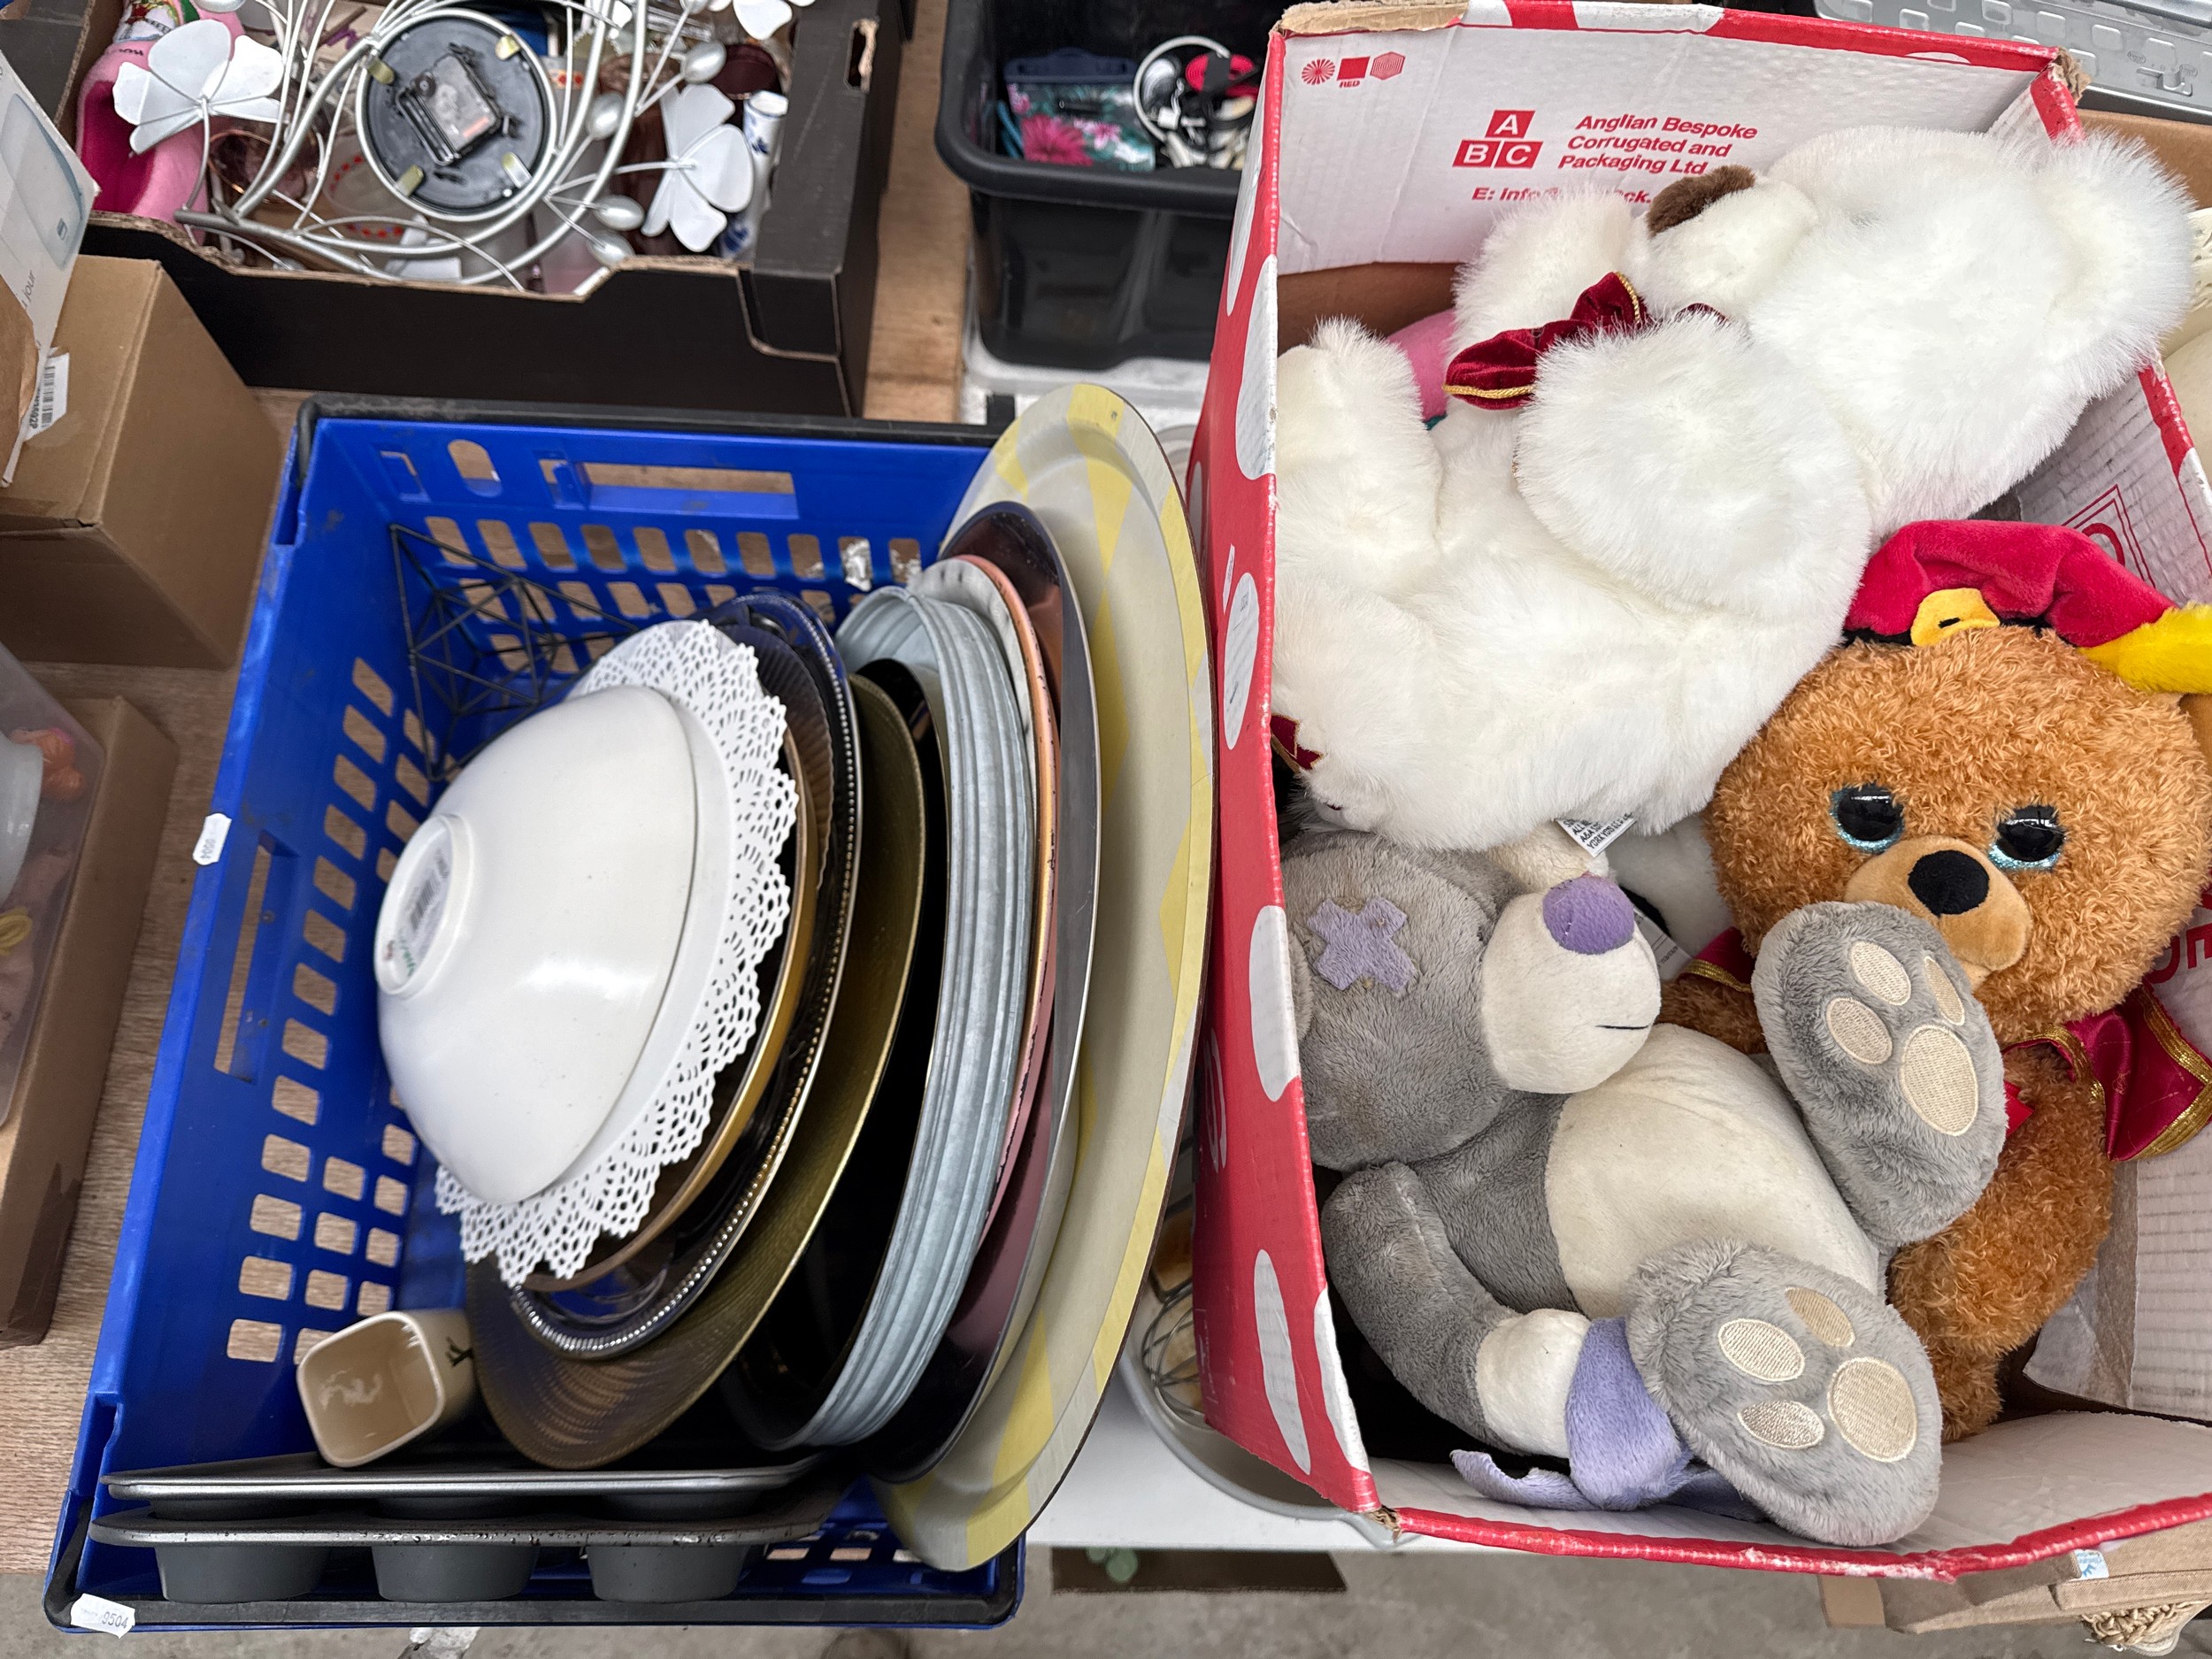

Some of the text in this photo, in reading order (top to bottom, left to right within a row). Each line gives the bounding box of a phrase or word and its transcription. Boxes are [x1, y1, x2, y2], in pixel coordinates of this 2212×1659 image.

[1494, 114, 1520, 135] A
[1575, 113, 1758, 140] Anglian Bespoke
[1567, 135, 1732, 157] Corrugated and
[1557, 154, 1708, 175] Packaging Ltd
[1471, 187, 1495, 202] E:
[101, 1611, 129, 1629] 9504
